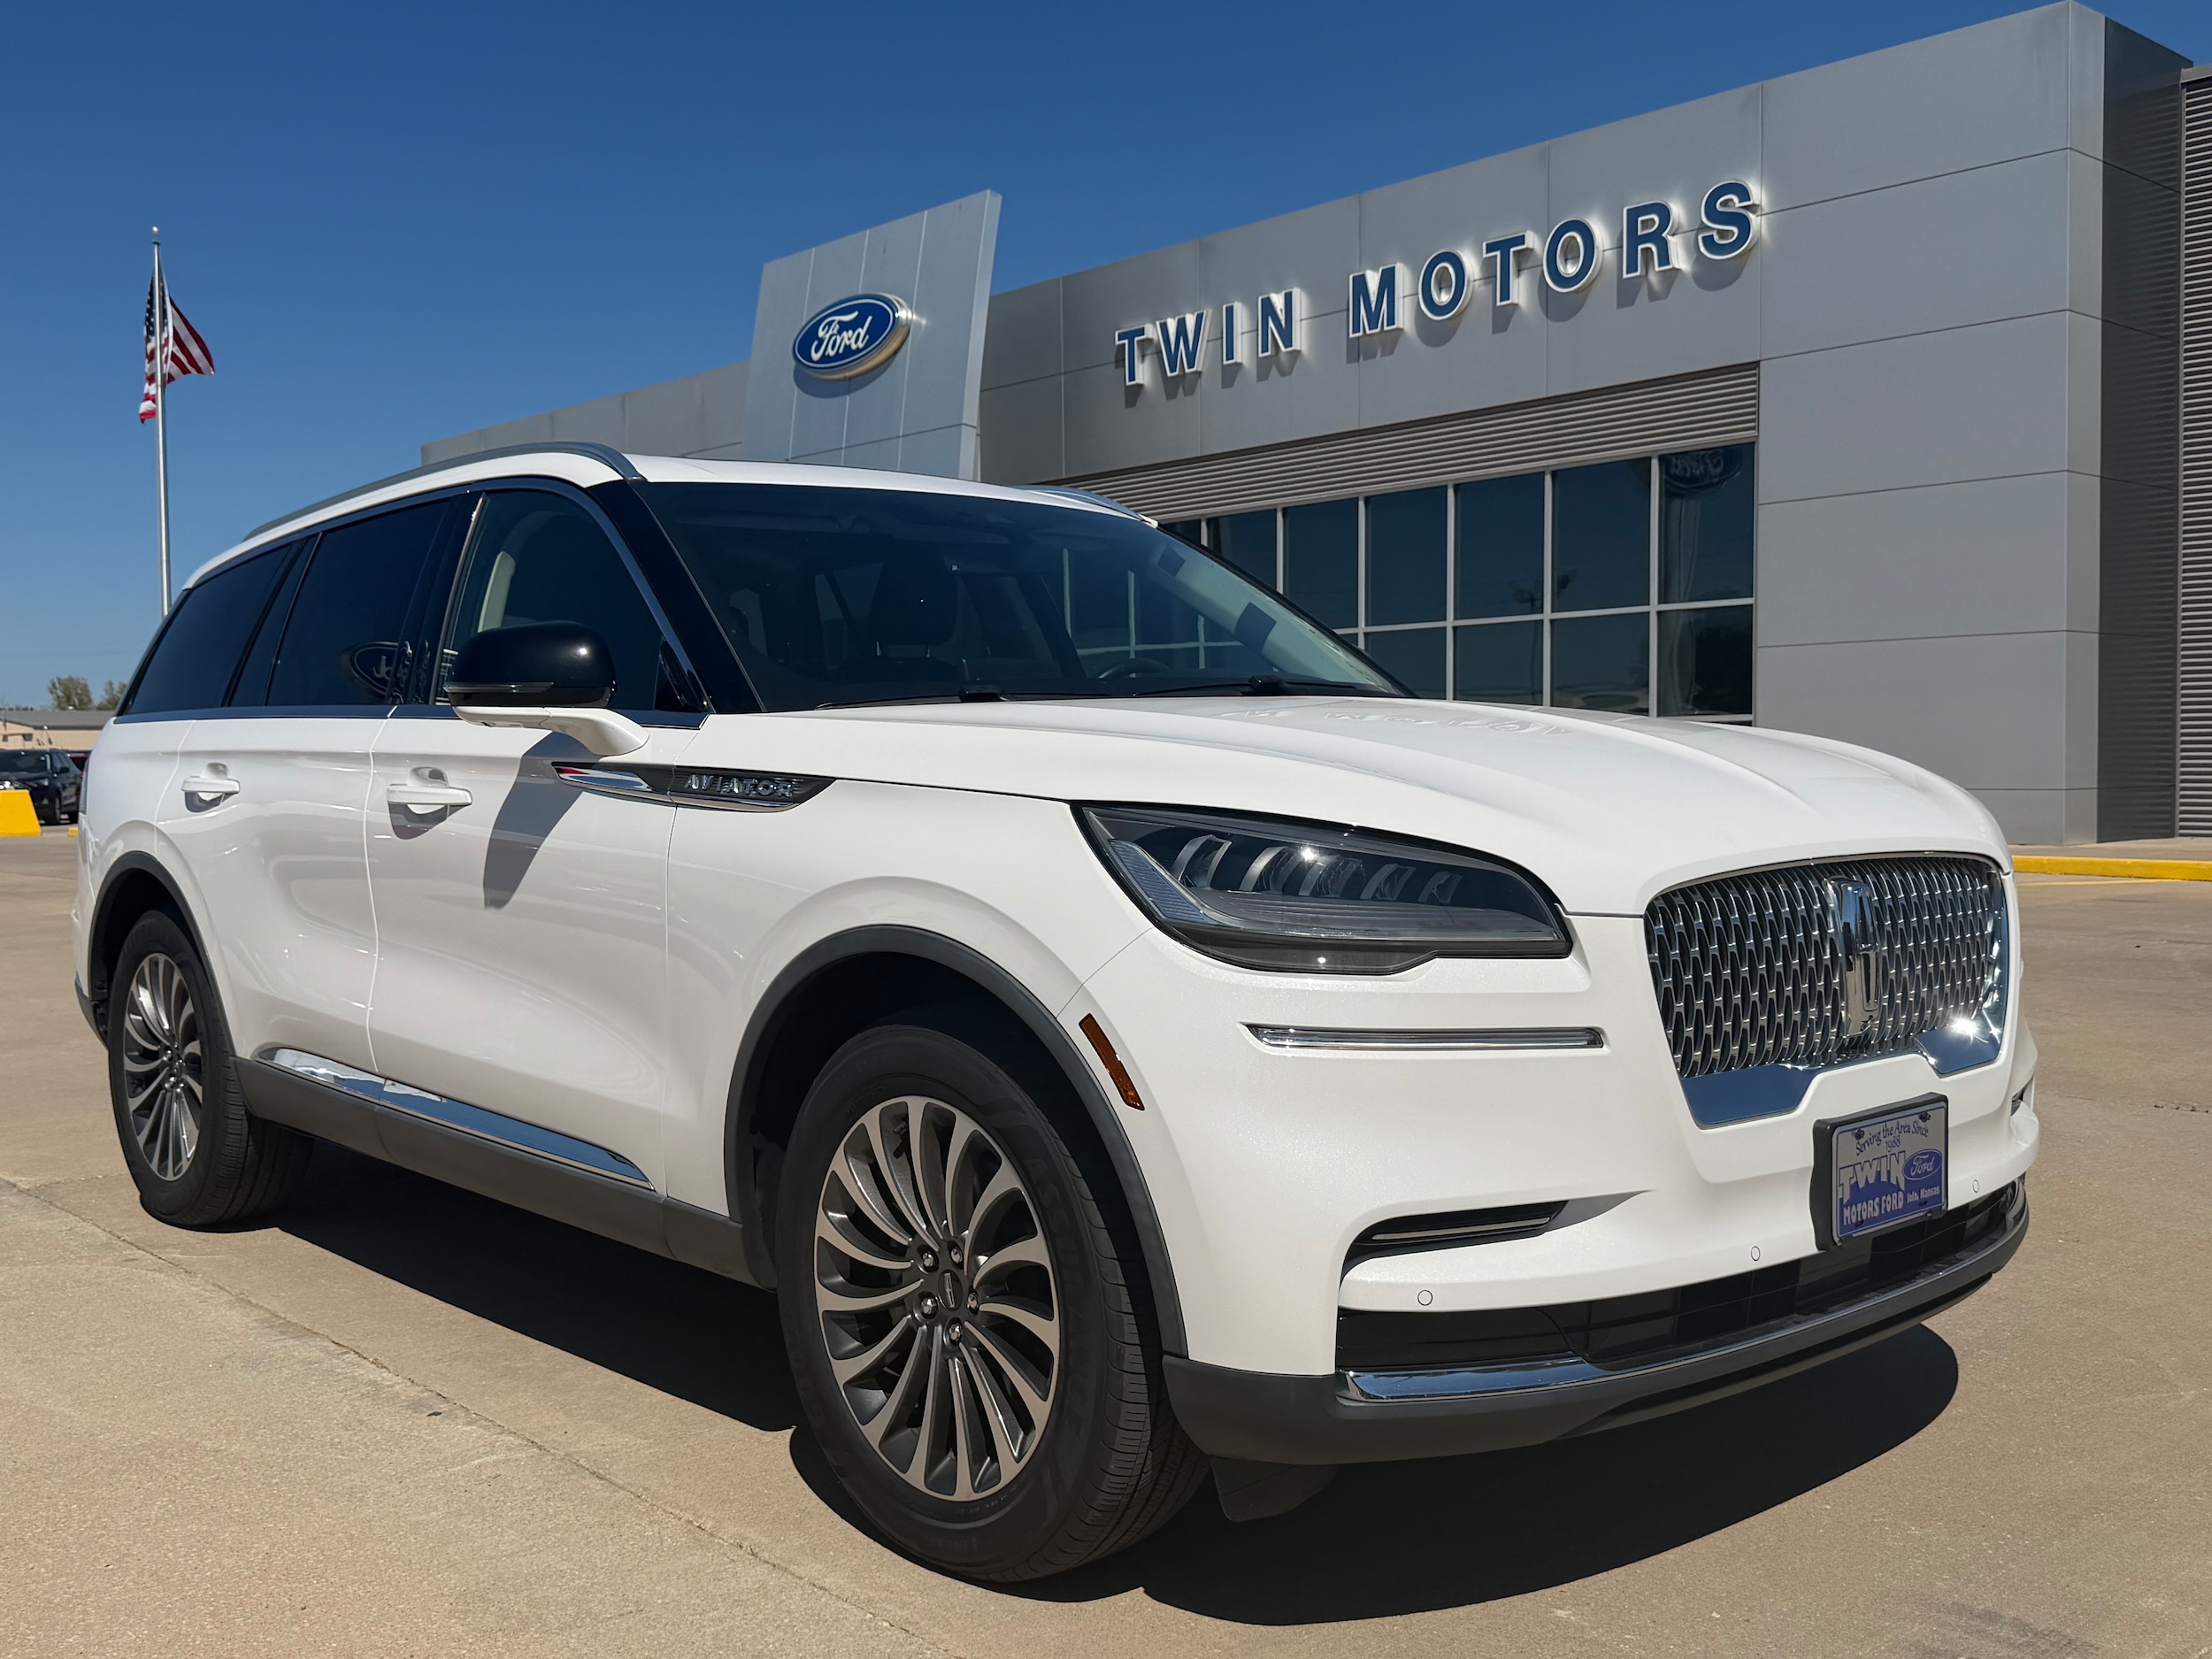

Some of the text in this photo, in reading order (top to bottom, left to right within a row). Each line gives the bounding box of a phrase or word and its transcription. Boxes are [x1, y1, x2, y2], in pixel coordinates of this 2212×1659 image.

[1115, 180, 1761, 386] TWIN MOTORS
[810, 311, 872, 361] Ford
[683, 773, 795, 797] AVIATOR
[1855, 1120, 1929, 1156] Serving the Area Since
[1886, 1135, 1901, 1152] 1988
[1839, 1150, 1906, 1205] TWIN
[1910, 1154, 1934, 1176] Ford
[1843, 1191, 1903, 1225] MOTORS FORD
[1920, 1185, 1939, 1199] Kansas
